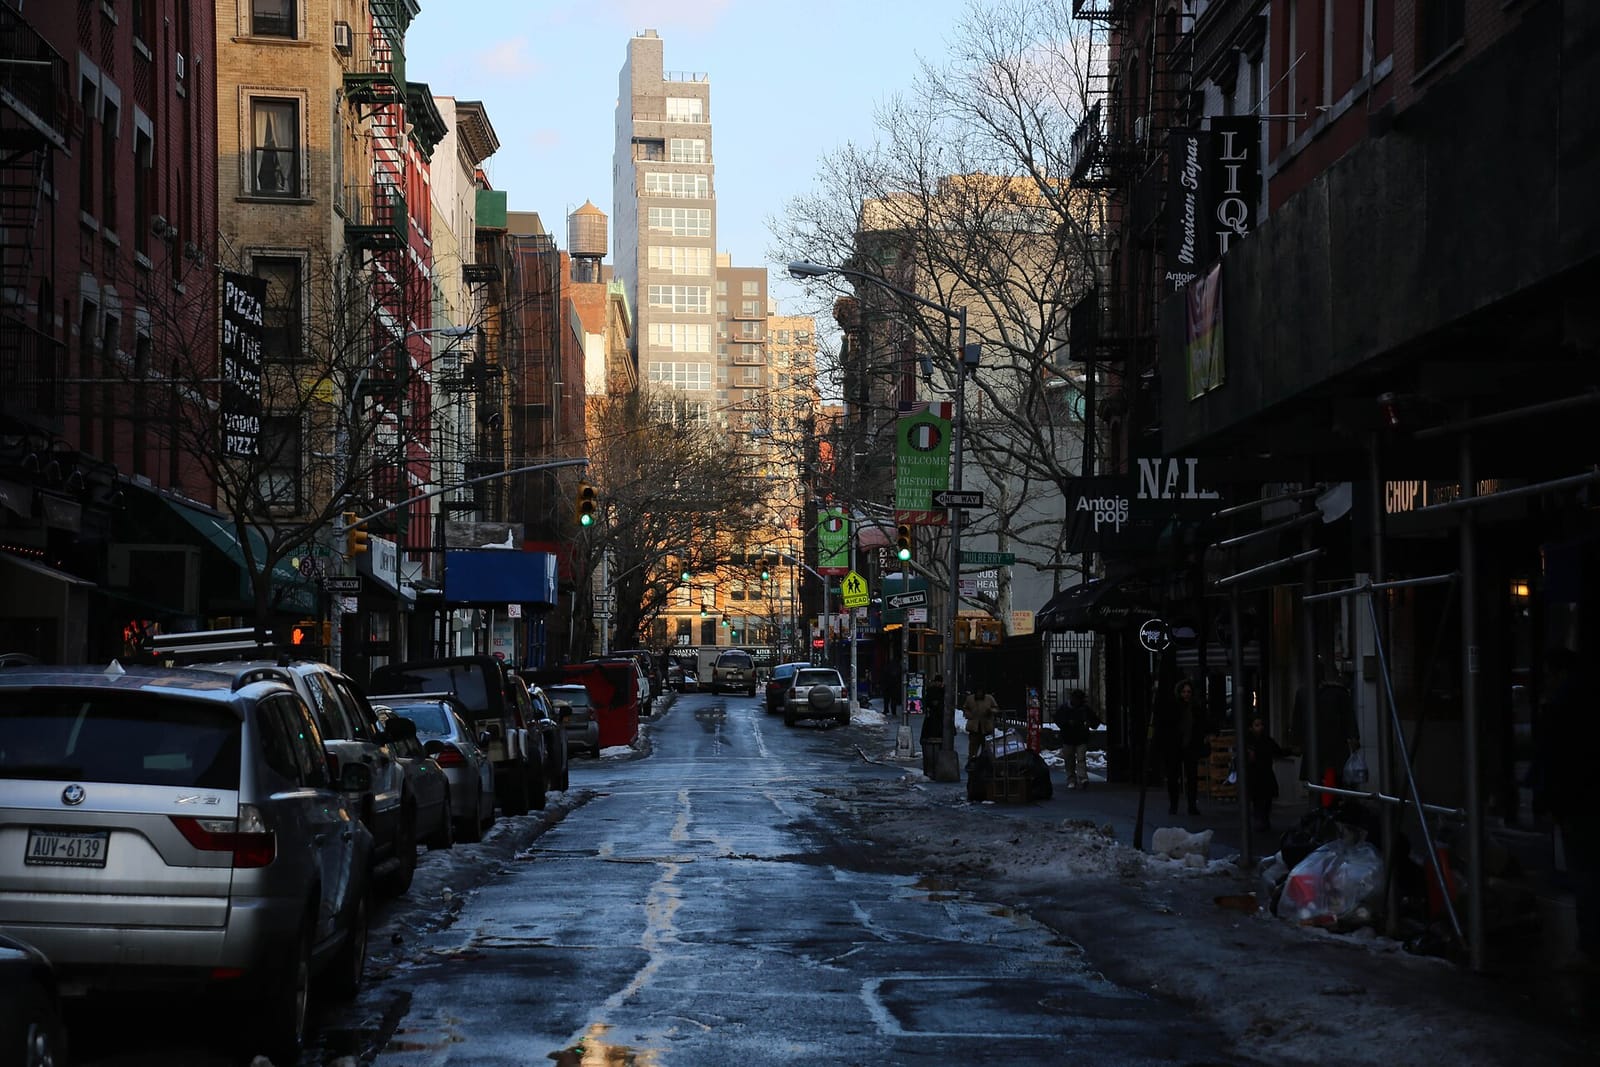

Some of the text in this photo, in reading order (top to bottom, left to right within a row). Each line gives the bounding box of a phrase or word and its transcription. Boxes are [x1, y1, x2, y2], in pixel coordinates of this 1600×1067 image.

[1178, 136, 1202, 264] Mexican Tapas
[226, 281, 263, 326] PIZZA
[224, 320, 261, 365] BY THE
[898, 456, 947, 465] WELCOME
[899, 467, 910, 475] TO
[898, 477, 943, 486] HISTORIC
[898, 488, 932, 497] LITTLE
[898, 499, 927, 508] ITALY
[1094, 510, 1128, 533] pop
[963, 552, 1001, 563] MULBERRY
[977, 570, 999, 579] JUDS
[977, 580, 999, 588] HEAL
